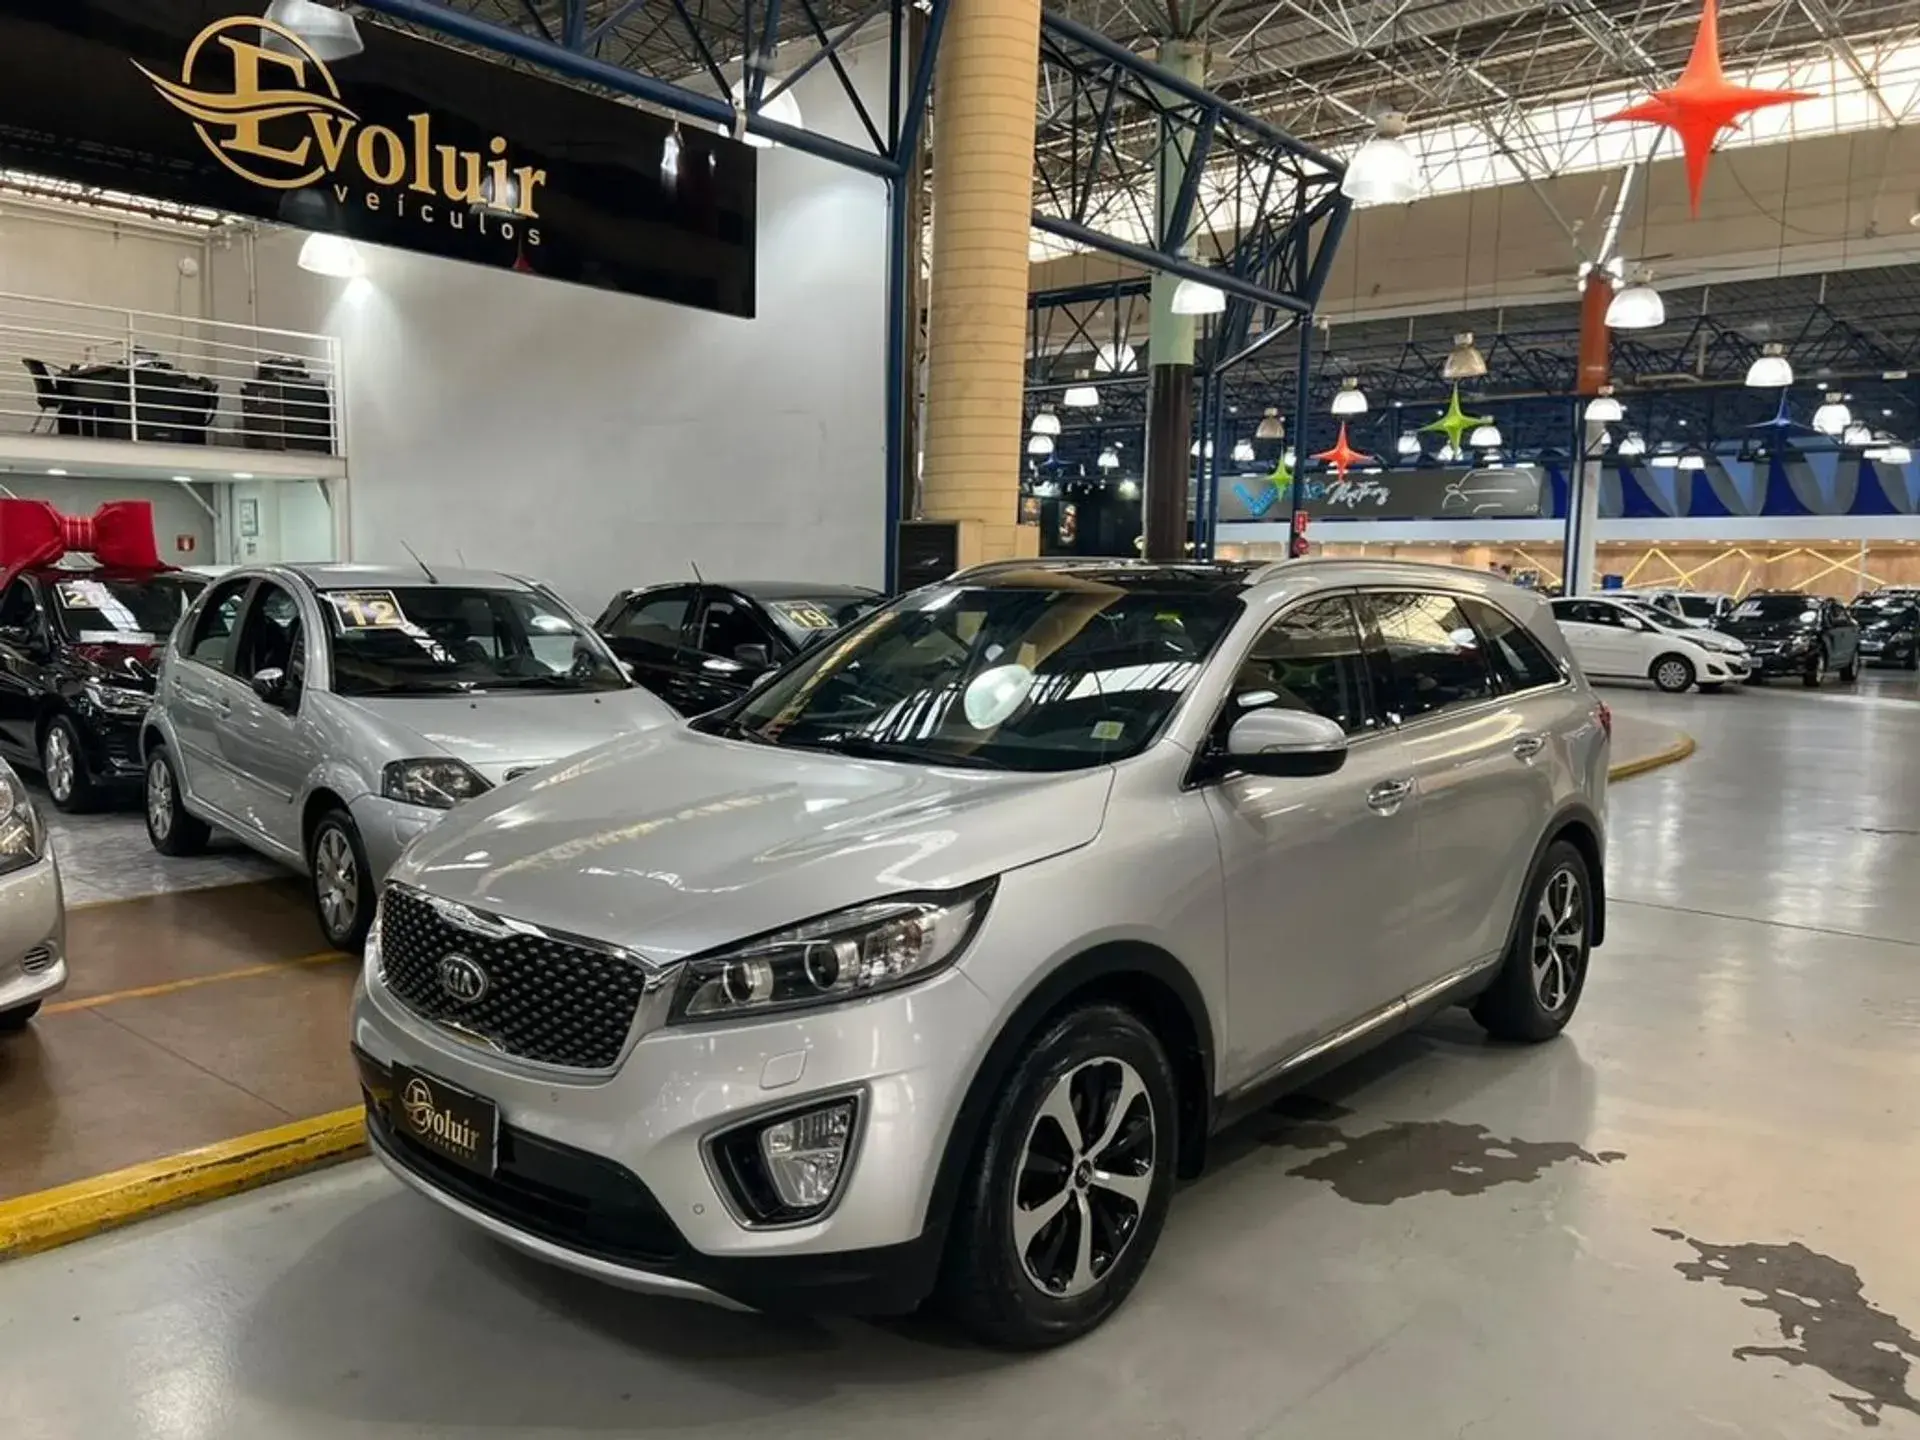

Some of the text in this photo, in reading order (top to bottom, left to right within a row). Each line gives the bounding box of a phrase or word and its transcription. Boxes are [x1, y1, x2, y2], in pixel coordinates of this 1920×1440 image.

[214, 35, 547, 219] Evoluir
[333, 184, 542, 246] veículos
[343, 600, 401, 625] 12
[789, 609, 828, 628] 19
